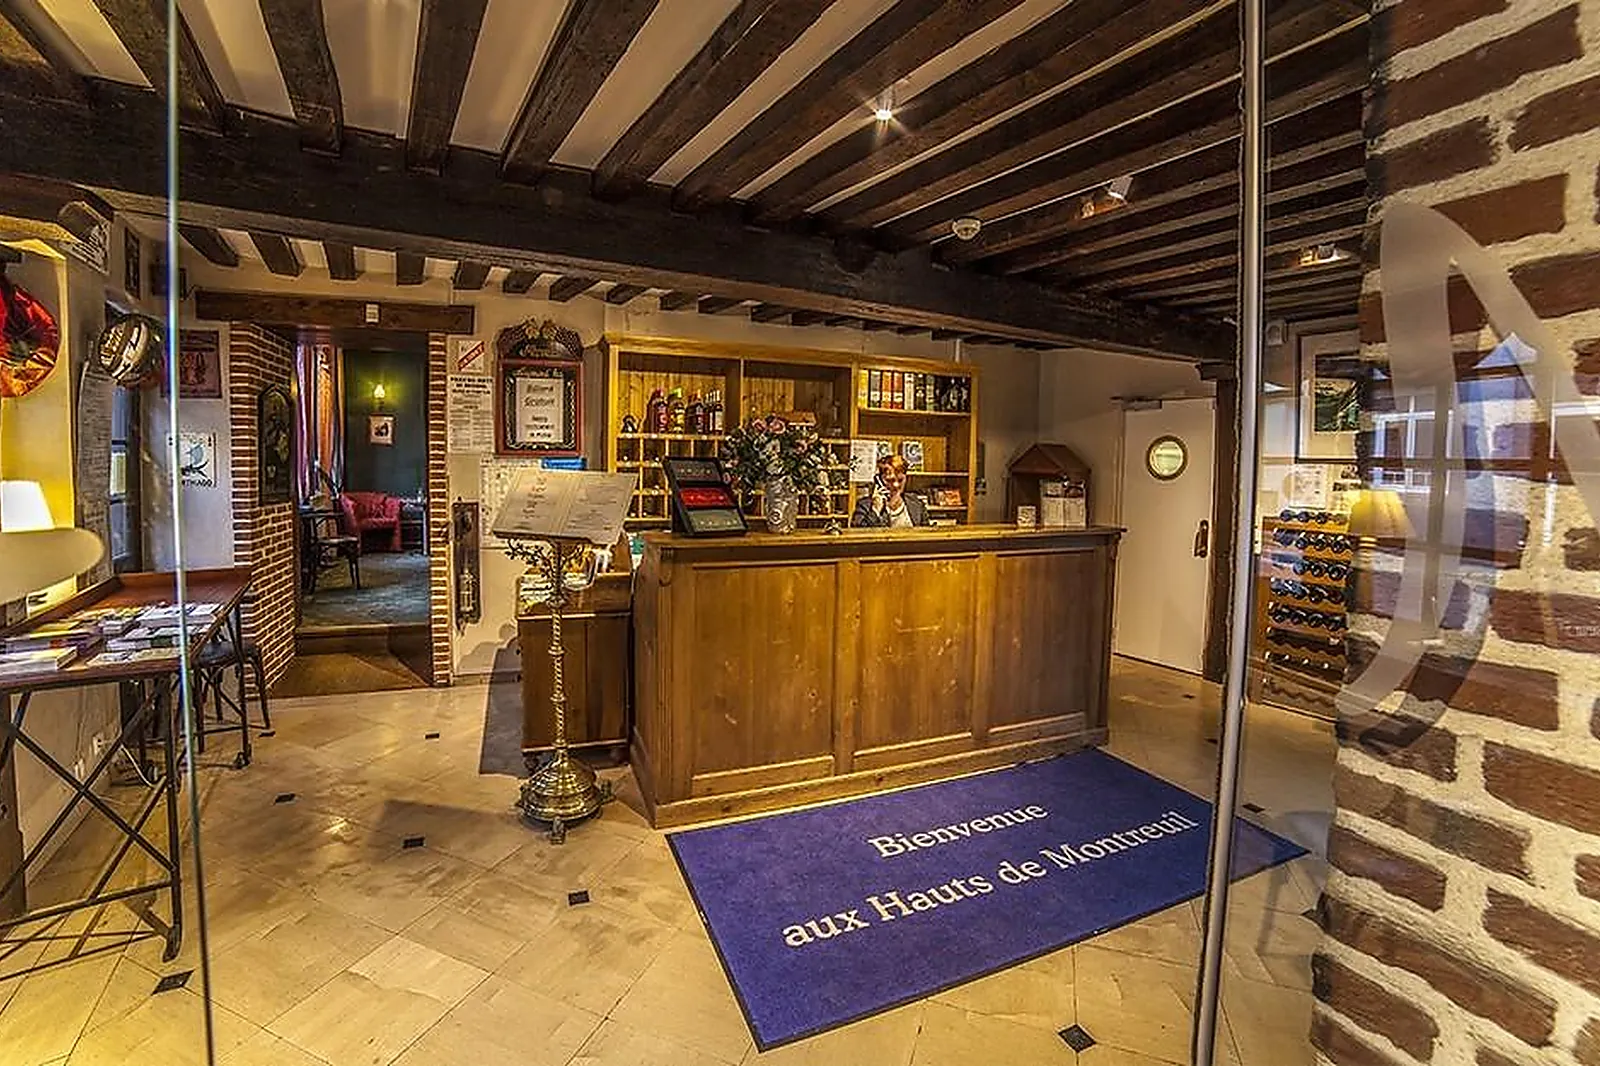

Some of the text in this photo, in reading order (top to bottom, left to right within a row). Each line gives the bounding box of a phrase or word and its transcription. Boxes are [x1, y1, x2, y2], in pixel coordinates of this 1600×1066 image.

[867, 804, 1048, 858] Bienvenue
[782, 811, 1199, 947] aux Hauts de Montreuil
